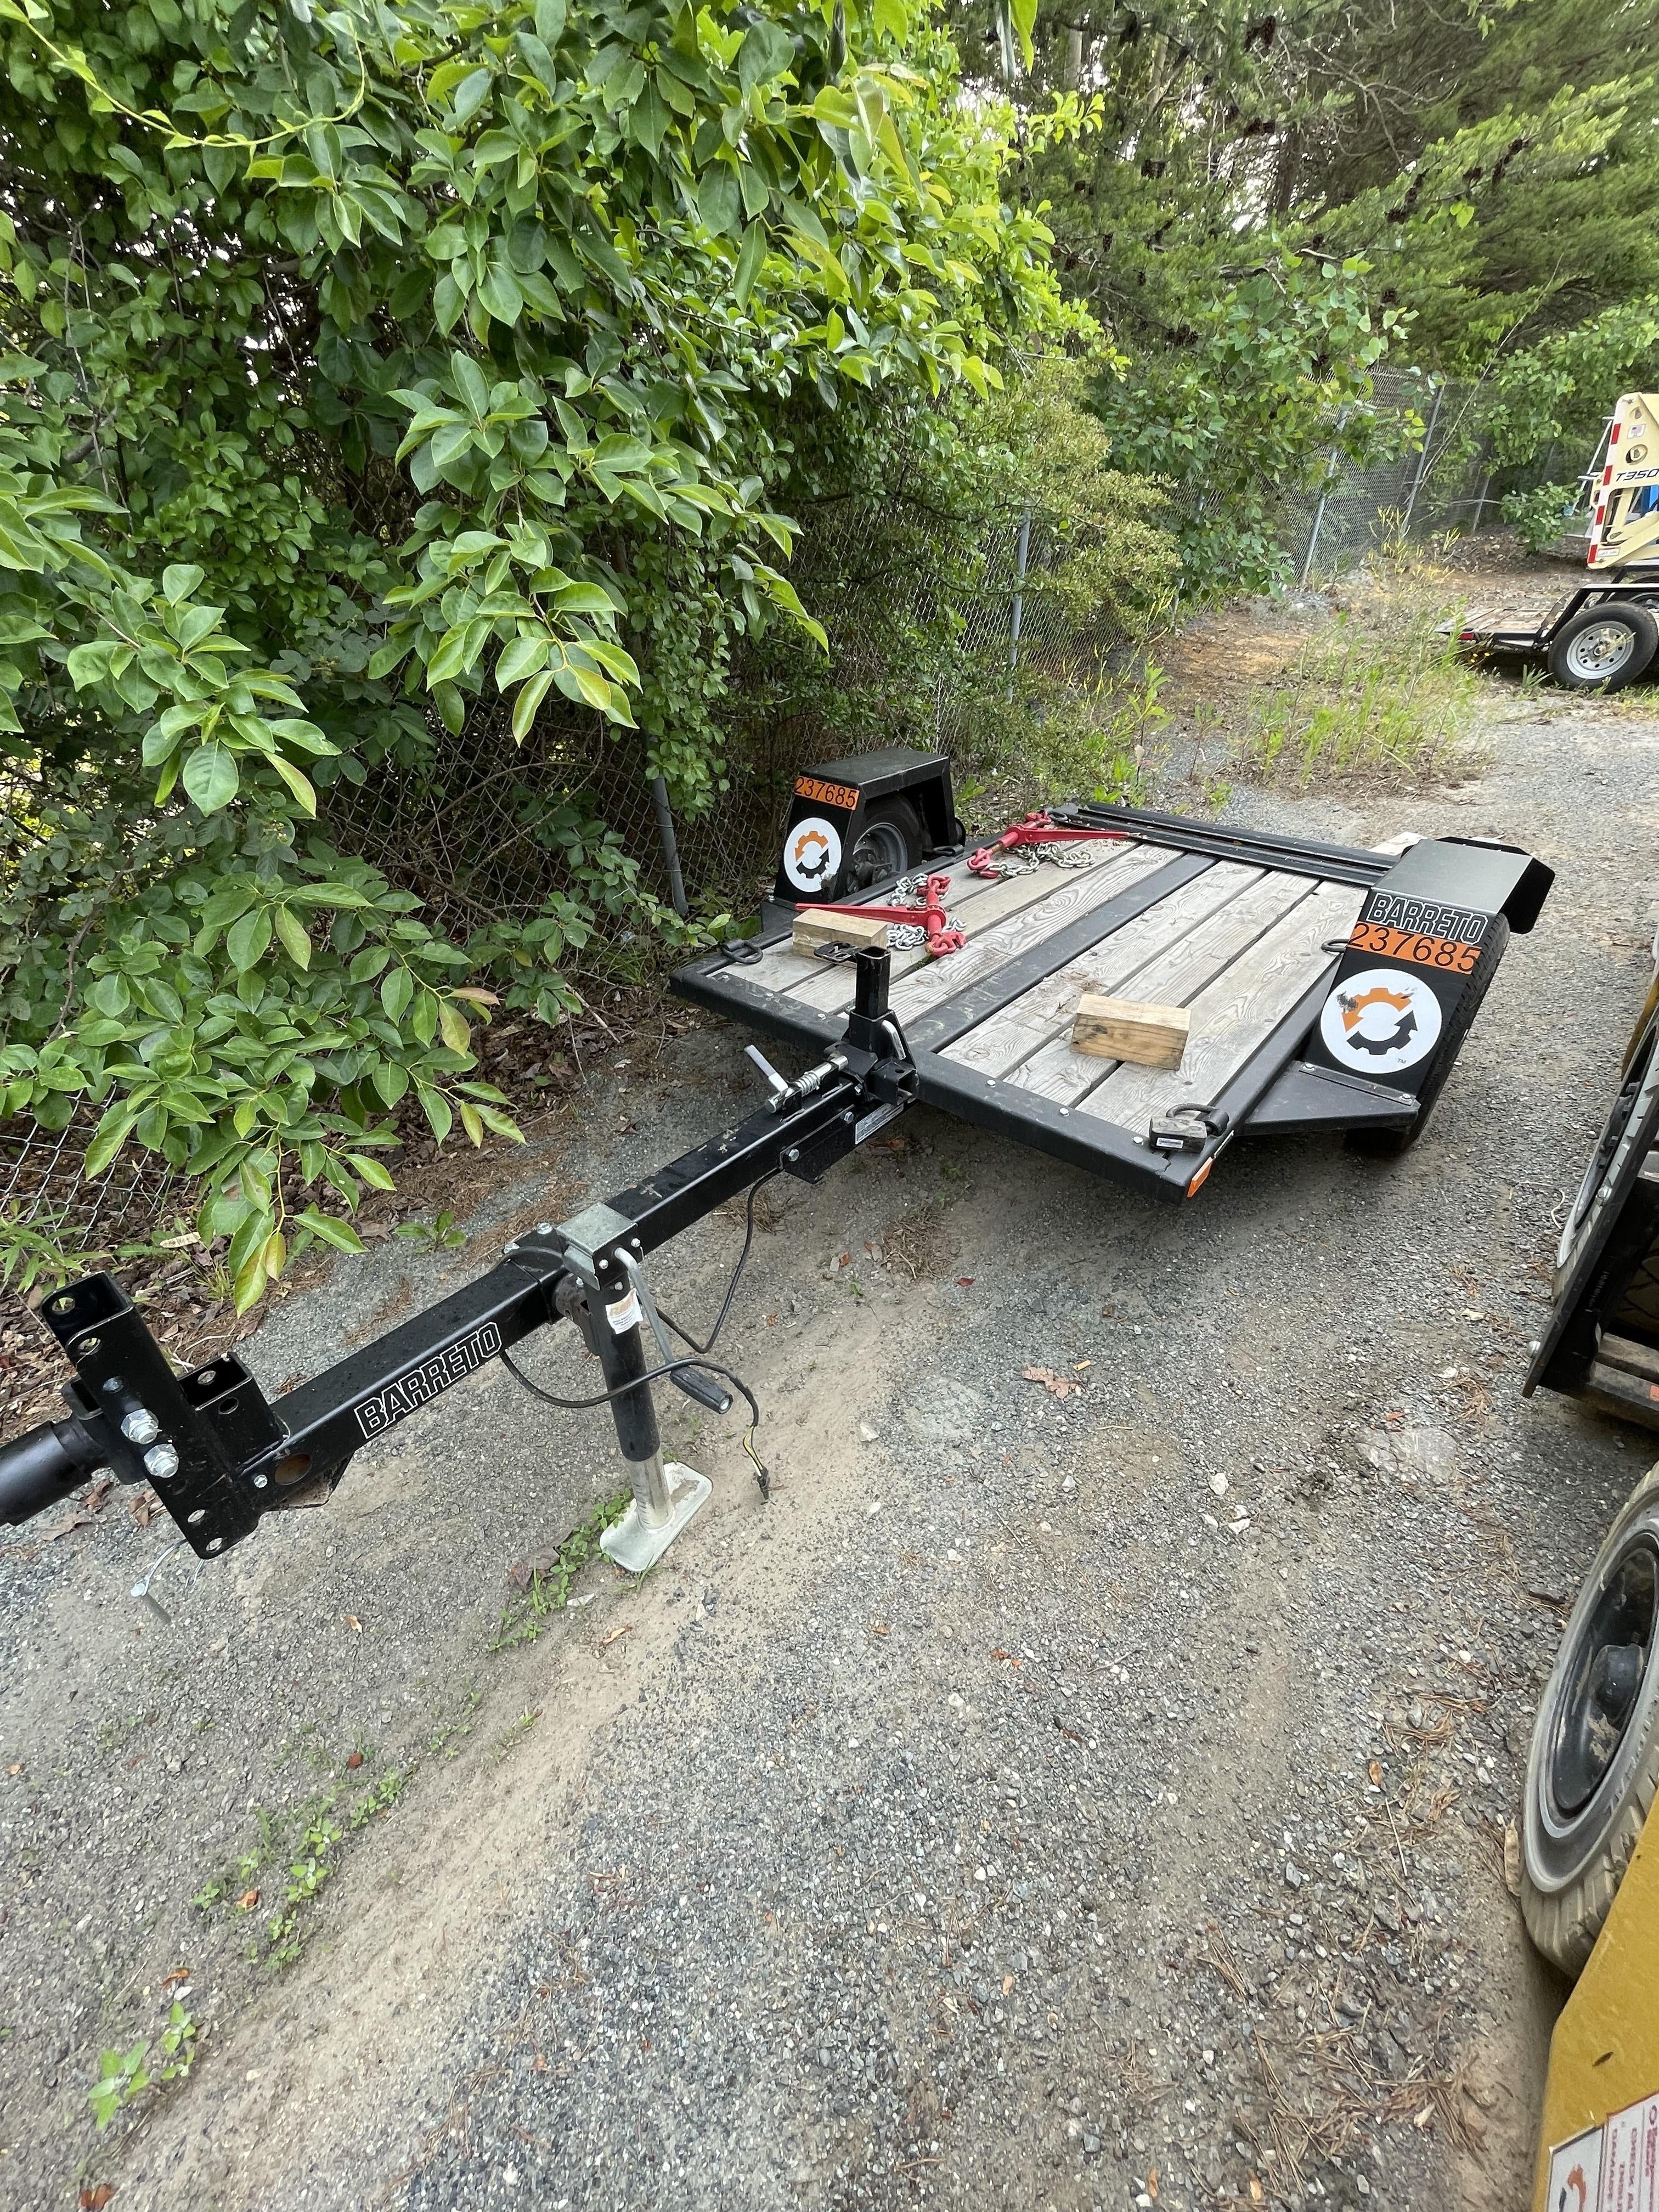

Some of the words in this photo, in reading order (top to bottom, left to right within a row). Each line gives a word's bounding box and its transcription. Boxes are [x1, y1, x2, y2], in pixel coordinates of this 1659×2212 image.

[794, 776, 856, 808] 237685
[1365, 893, 1488, 945] BARRETO
[1348, 923, 1481, 972] 237685
[354, 1322, 502, 1440] BARRETO
